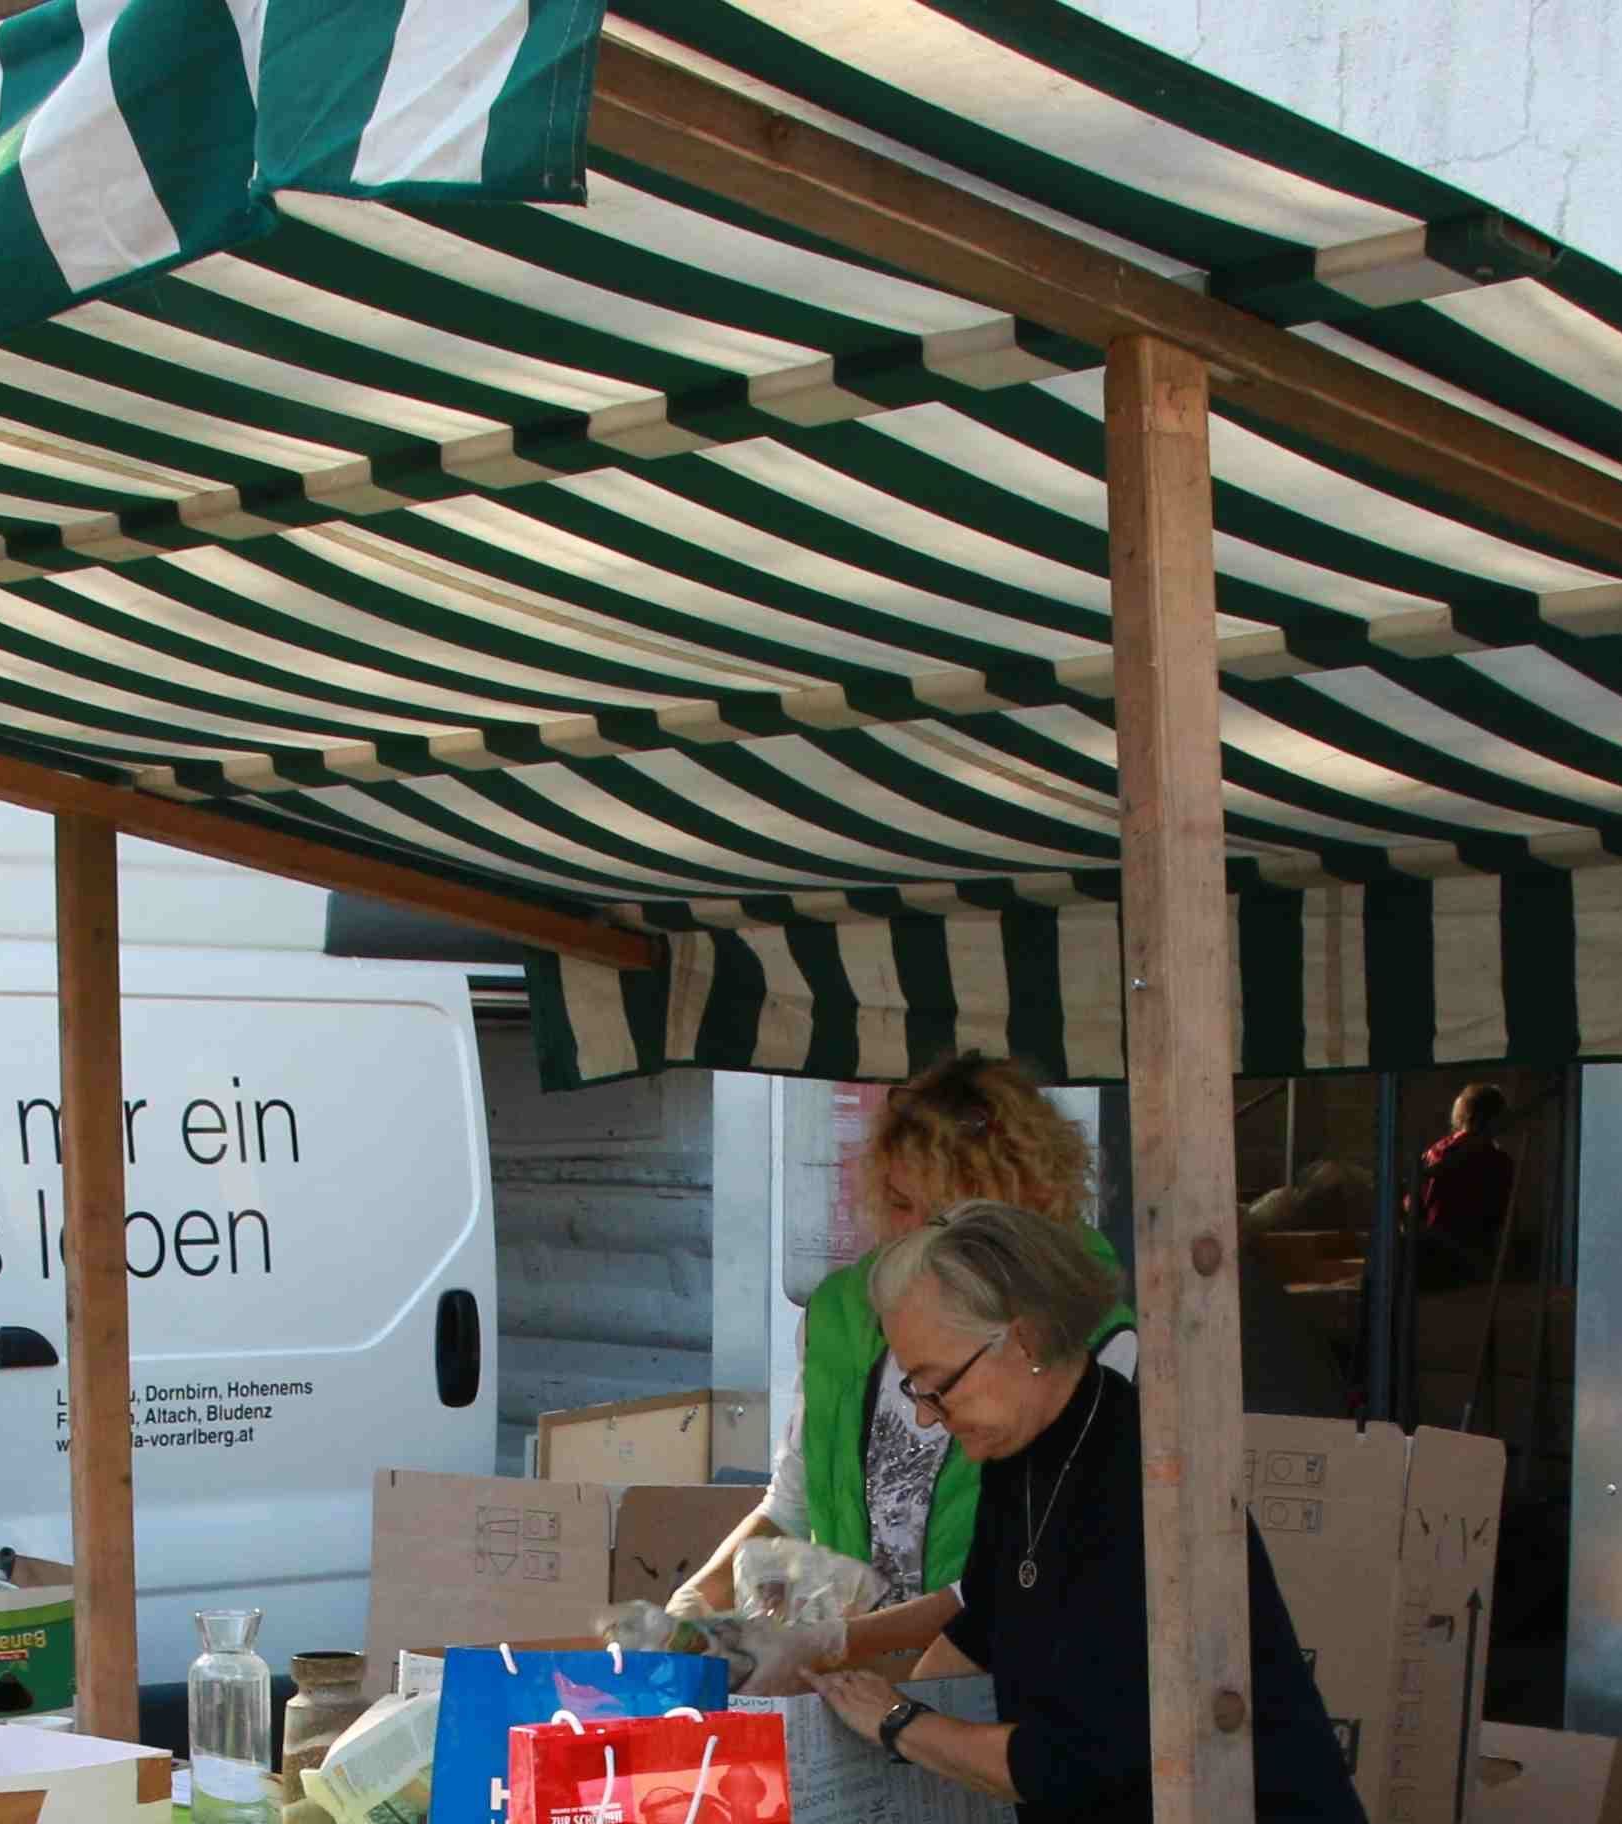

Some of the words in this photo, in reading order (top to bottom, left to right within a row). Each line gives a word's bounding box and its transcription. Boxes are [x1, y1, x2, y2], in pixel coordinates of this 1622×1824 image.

[17, 1098, 148, 1166] mr
[182, 1076, 300, 1165] ein
[146, 1385, 223, 1404] Dornbirn,
[227, 1381, 313, 1399] Hohenems
[145, 1405, 202, 1425] Altach,
[207, 1403, 273, 1422] Bludenz
